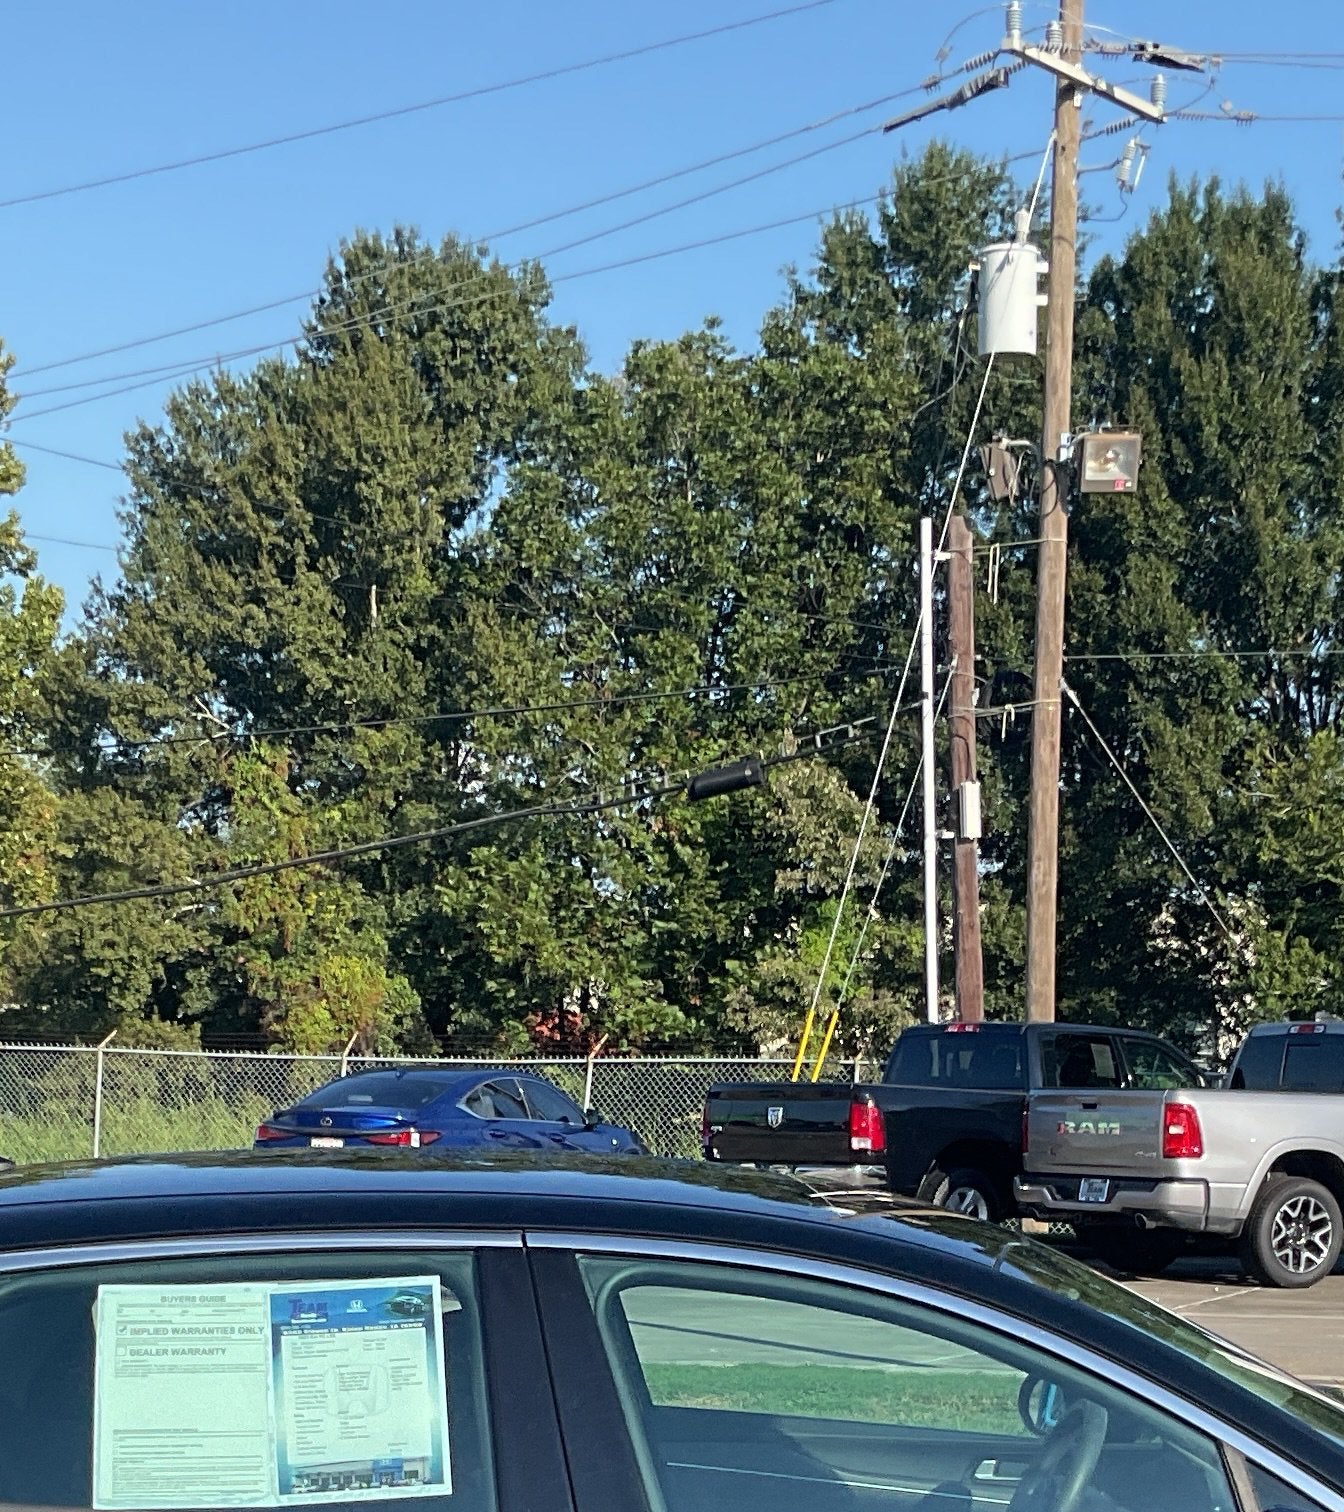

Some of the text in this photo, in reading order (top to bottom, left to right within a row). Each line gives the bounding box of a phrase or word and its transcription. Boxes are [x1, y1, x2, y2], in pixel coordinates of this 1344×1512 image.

[1057, 1121, 1120, 1135] RAM
[199, 1295, 227, 1303] GUIDE
[130, 1326, 265, 1336] IMPLIED WARRANTIES ONLY
[129, 1347, 227, 1357] DEALER WARRANTY
